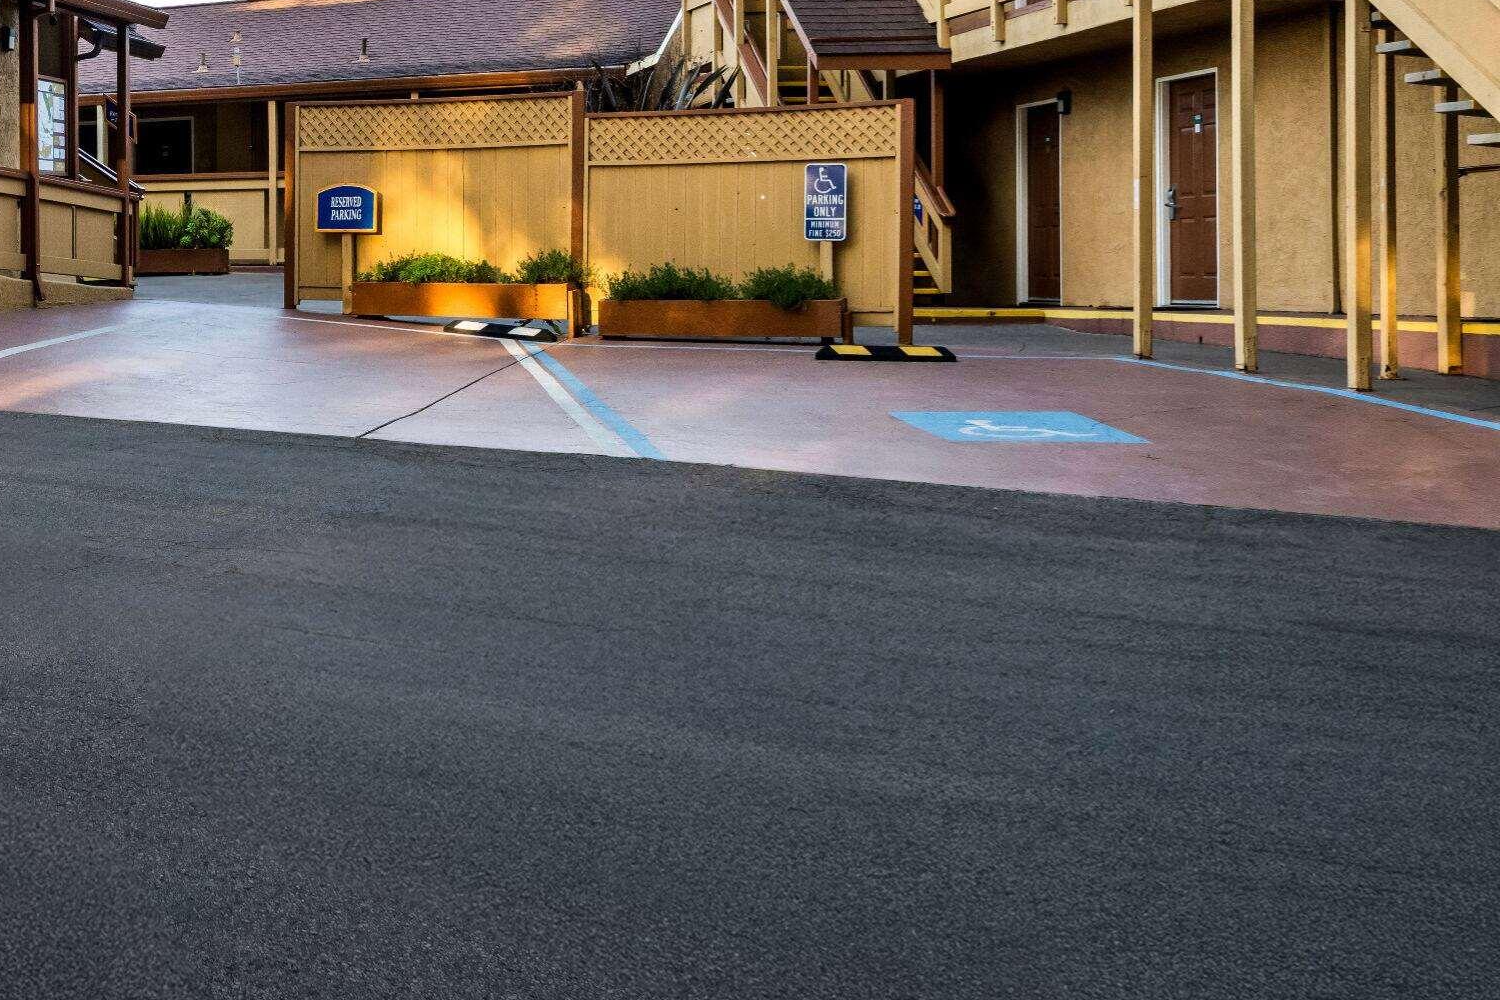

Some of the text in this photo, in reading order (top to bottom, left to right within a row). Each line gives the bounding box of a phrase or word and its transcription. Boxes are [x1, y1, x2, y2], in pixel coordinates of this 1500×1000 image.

[330, 196, 362, 207] RESERVED
[806, 194, 844, 205] PARKING
[330, 209, 362, 220] PARKING
[813, 206, 837, 217] ONLY
[810, 220, 840, 229] MINIMUM
[808, 229, 823, 237] FINE
